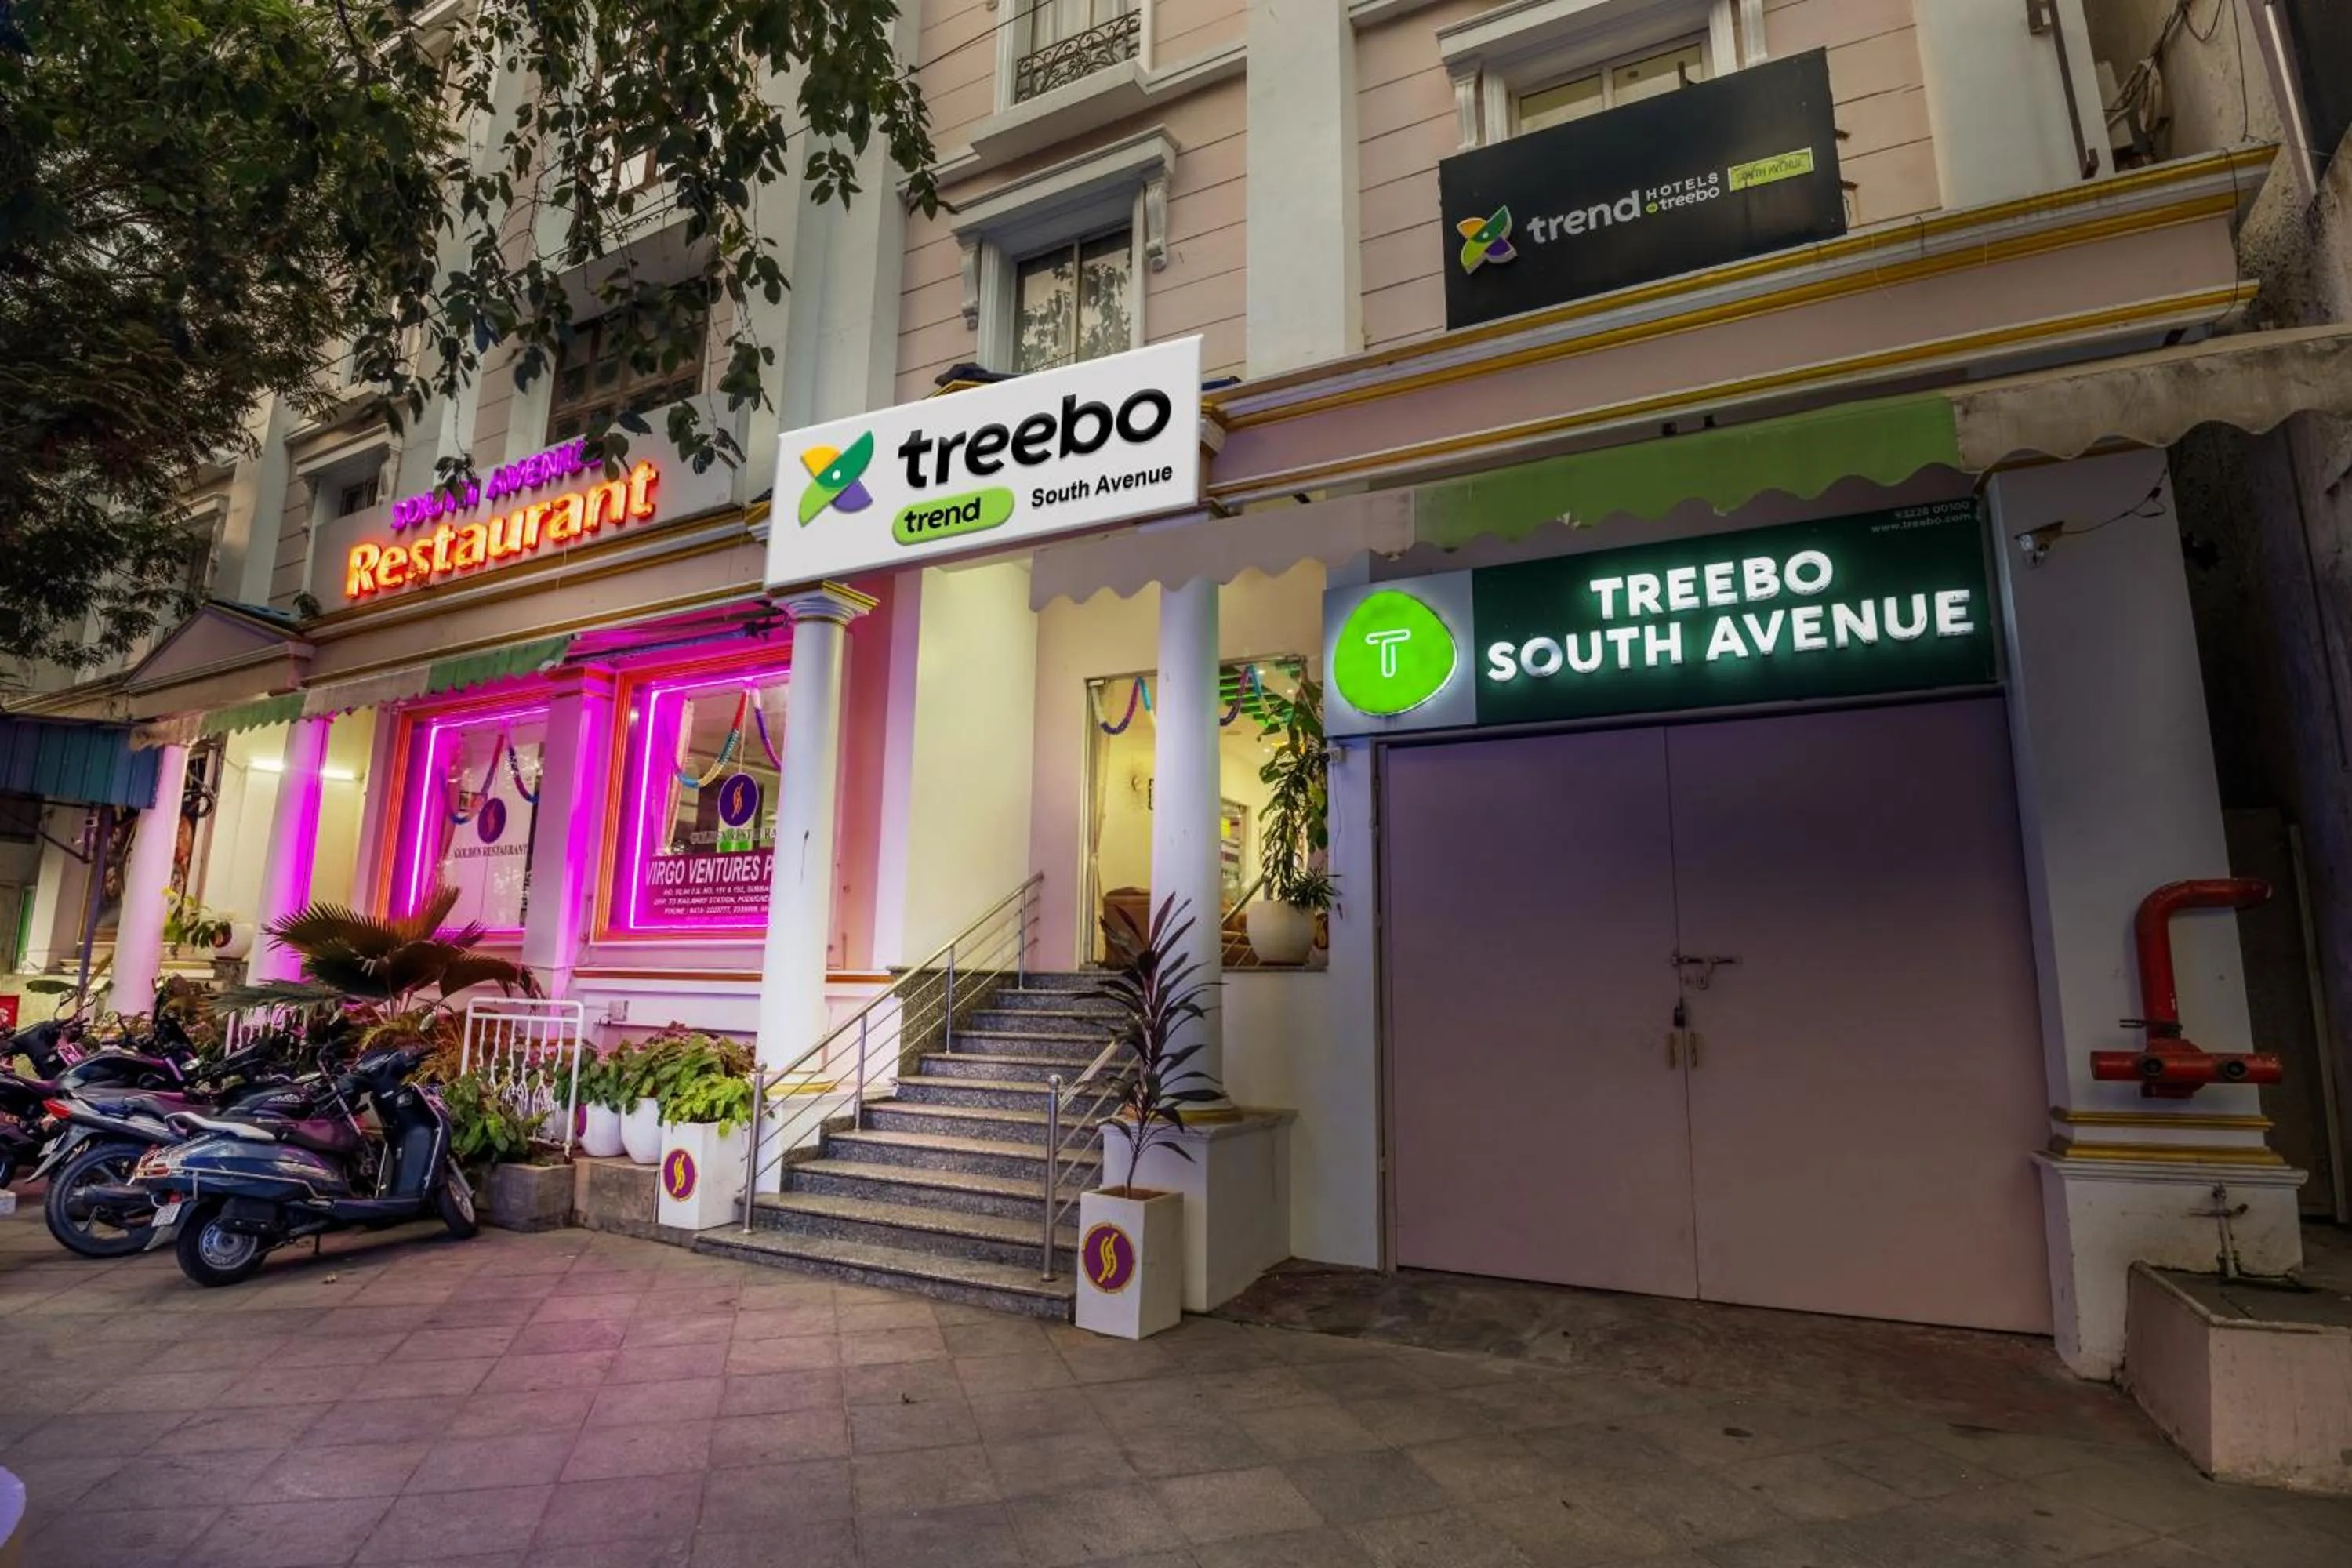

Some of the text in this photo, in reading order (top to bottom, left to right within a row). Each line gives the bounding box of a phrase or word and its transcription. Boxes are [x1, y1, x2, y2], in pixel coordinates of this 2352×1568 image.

[1646, 172, 1719, 201] HOTELS
[1658, 186, 1721, 211] treebo
[1526, 189, 1640, 245] trend
[898, 388, 1172, 489] treebo
[1031, 465, 1174, 509] South Avenue
[344, 459, 659, 600] Restaurant
[903, 497, 982, 534] trend
[1871, 513, 1972, 533] www.treebo.com
[1590, 550, 1835, 620] TREEBO
[1365, 629, 1412, 679] T
[1486, 588, 1975, 684] SOUTH AVENUE
[645, 860, 685, 886] VIRGO
[688, 856, 760, 884] VENTURES
